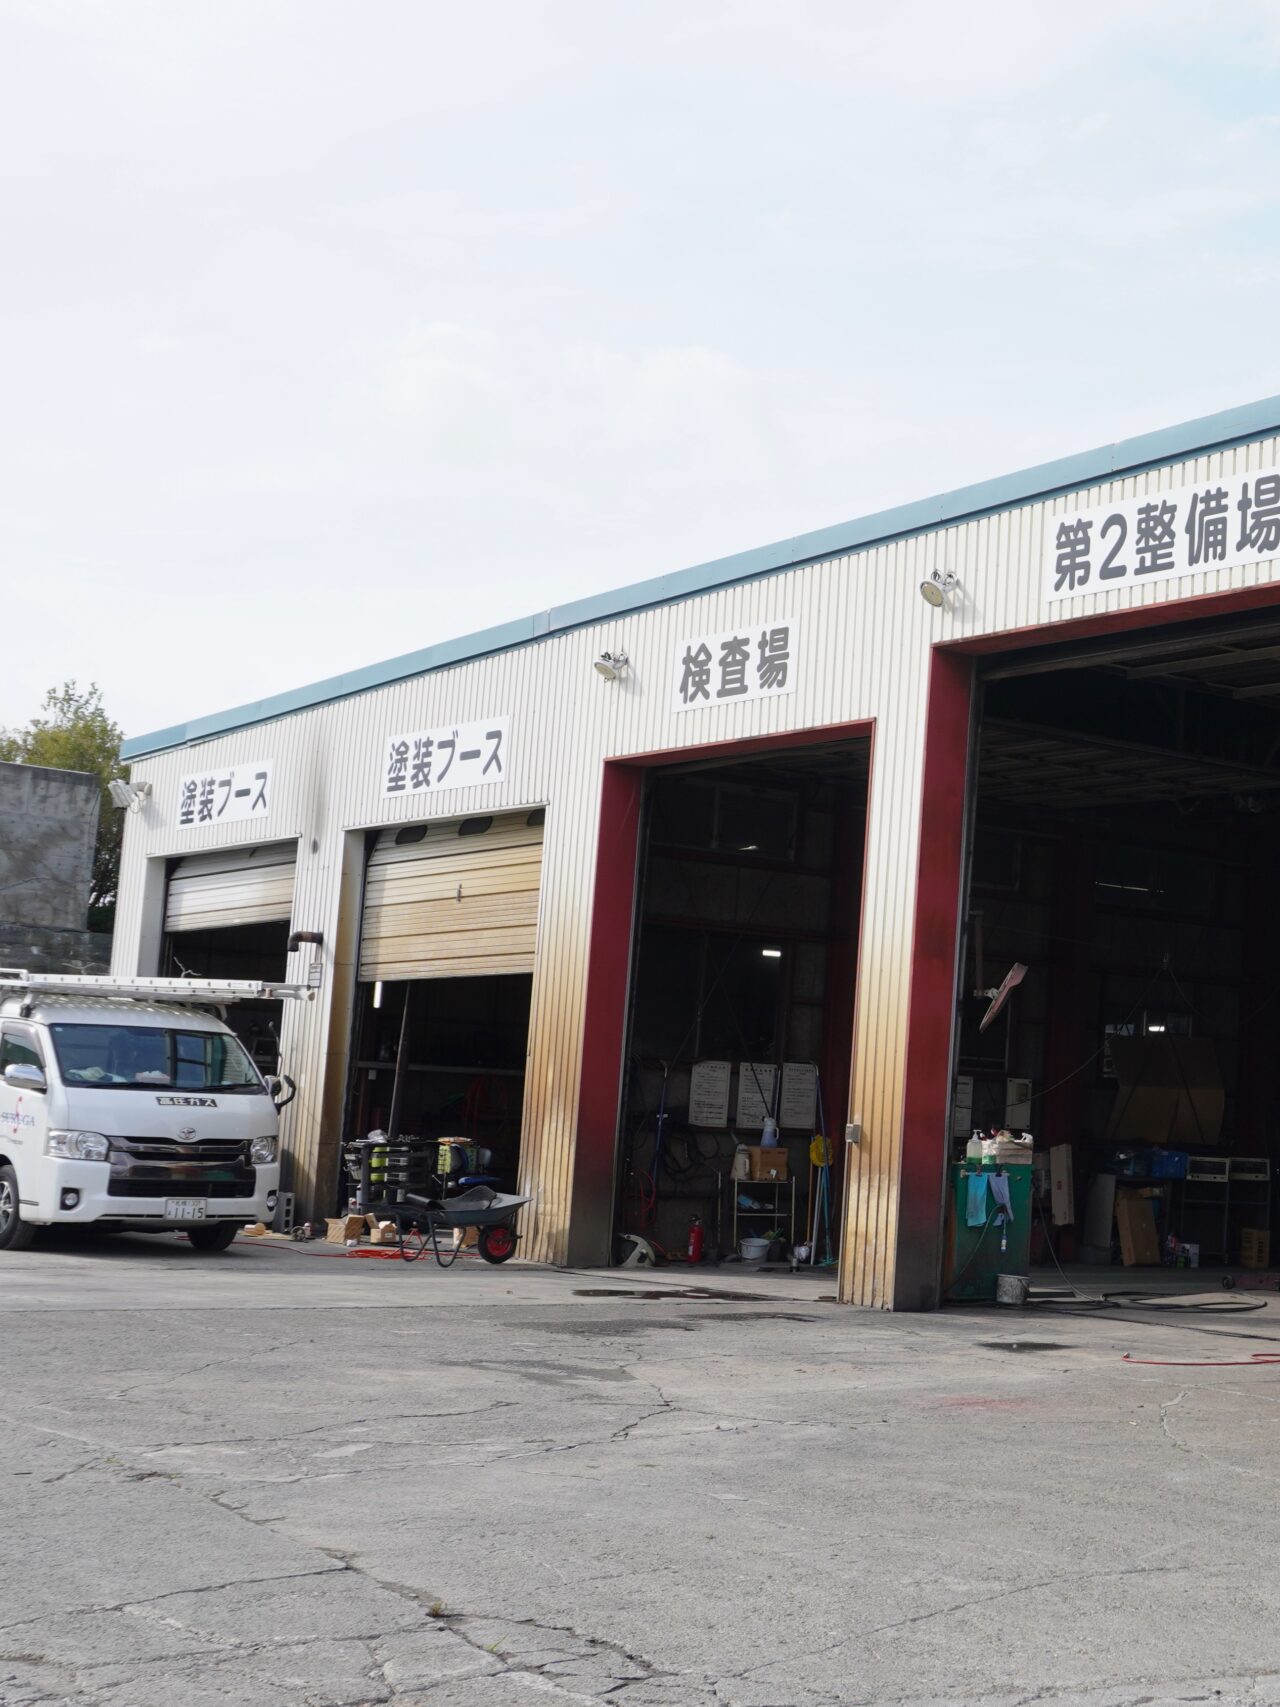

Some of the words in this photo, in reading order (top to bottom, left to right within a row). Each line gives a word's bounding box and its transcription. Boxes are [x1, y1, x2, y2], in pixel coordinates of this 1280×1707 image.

[679, 626, 792, 706] 検査場
[385, 728, 504, 794] 塗装ブース
[180, 770, 269, 826] 塗装ブース
[158, 1097, 215, 1107] 高圧ガス
[174, 1207, 204, 1219] 11-15
